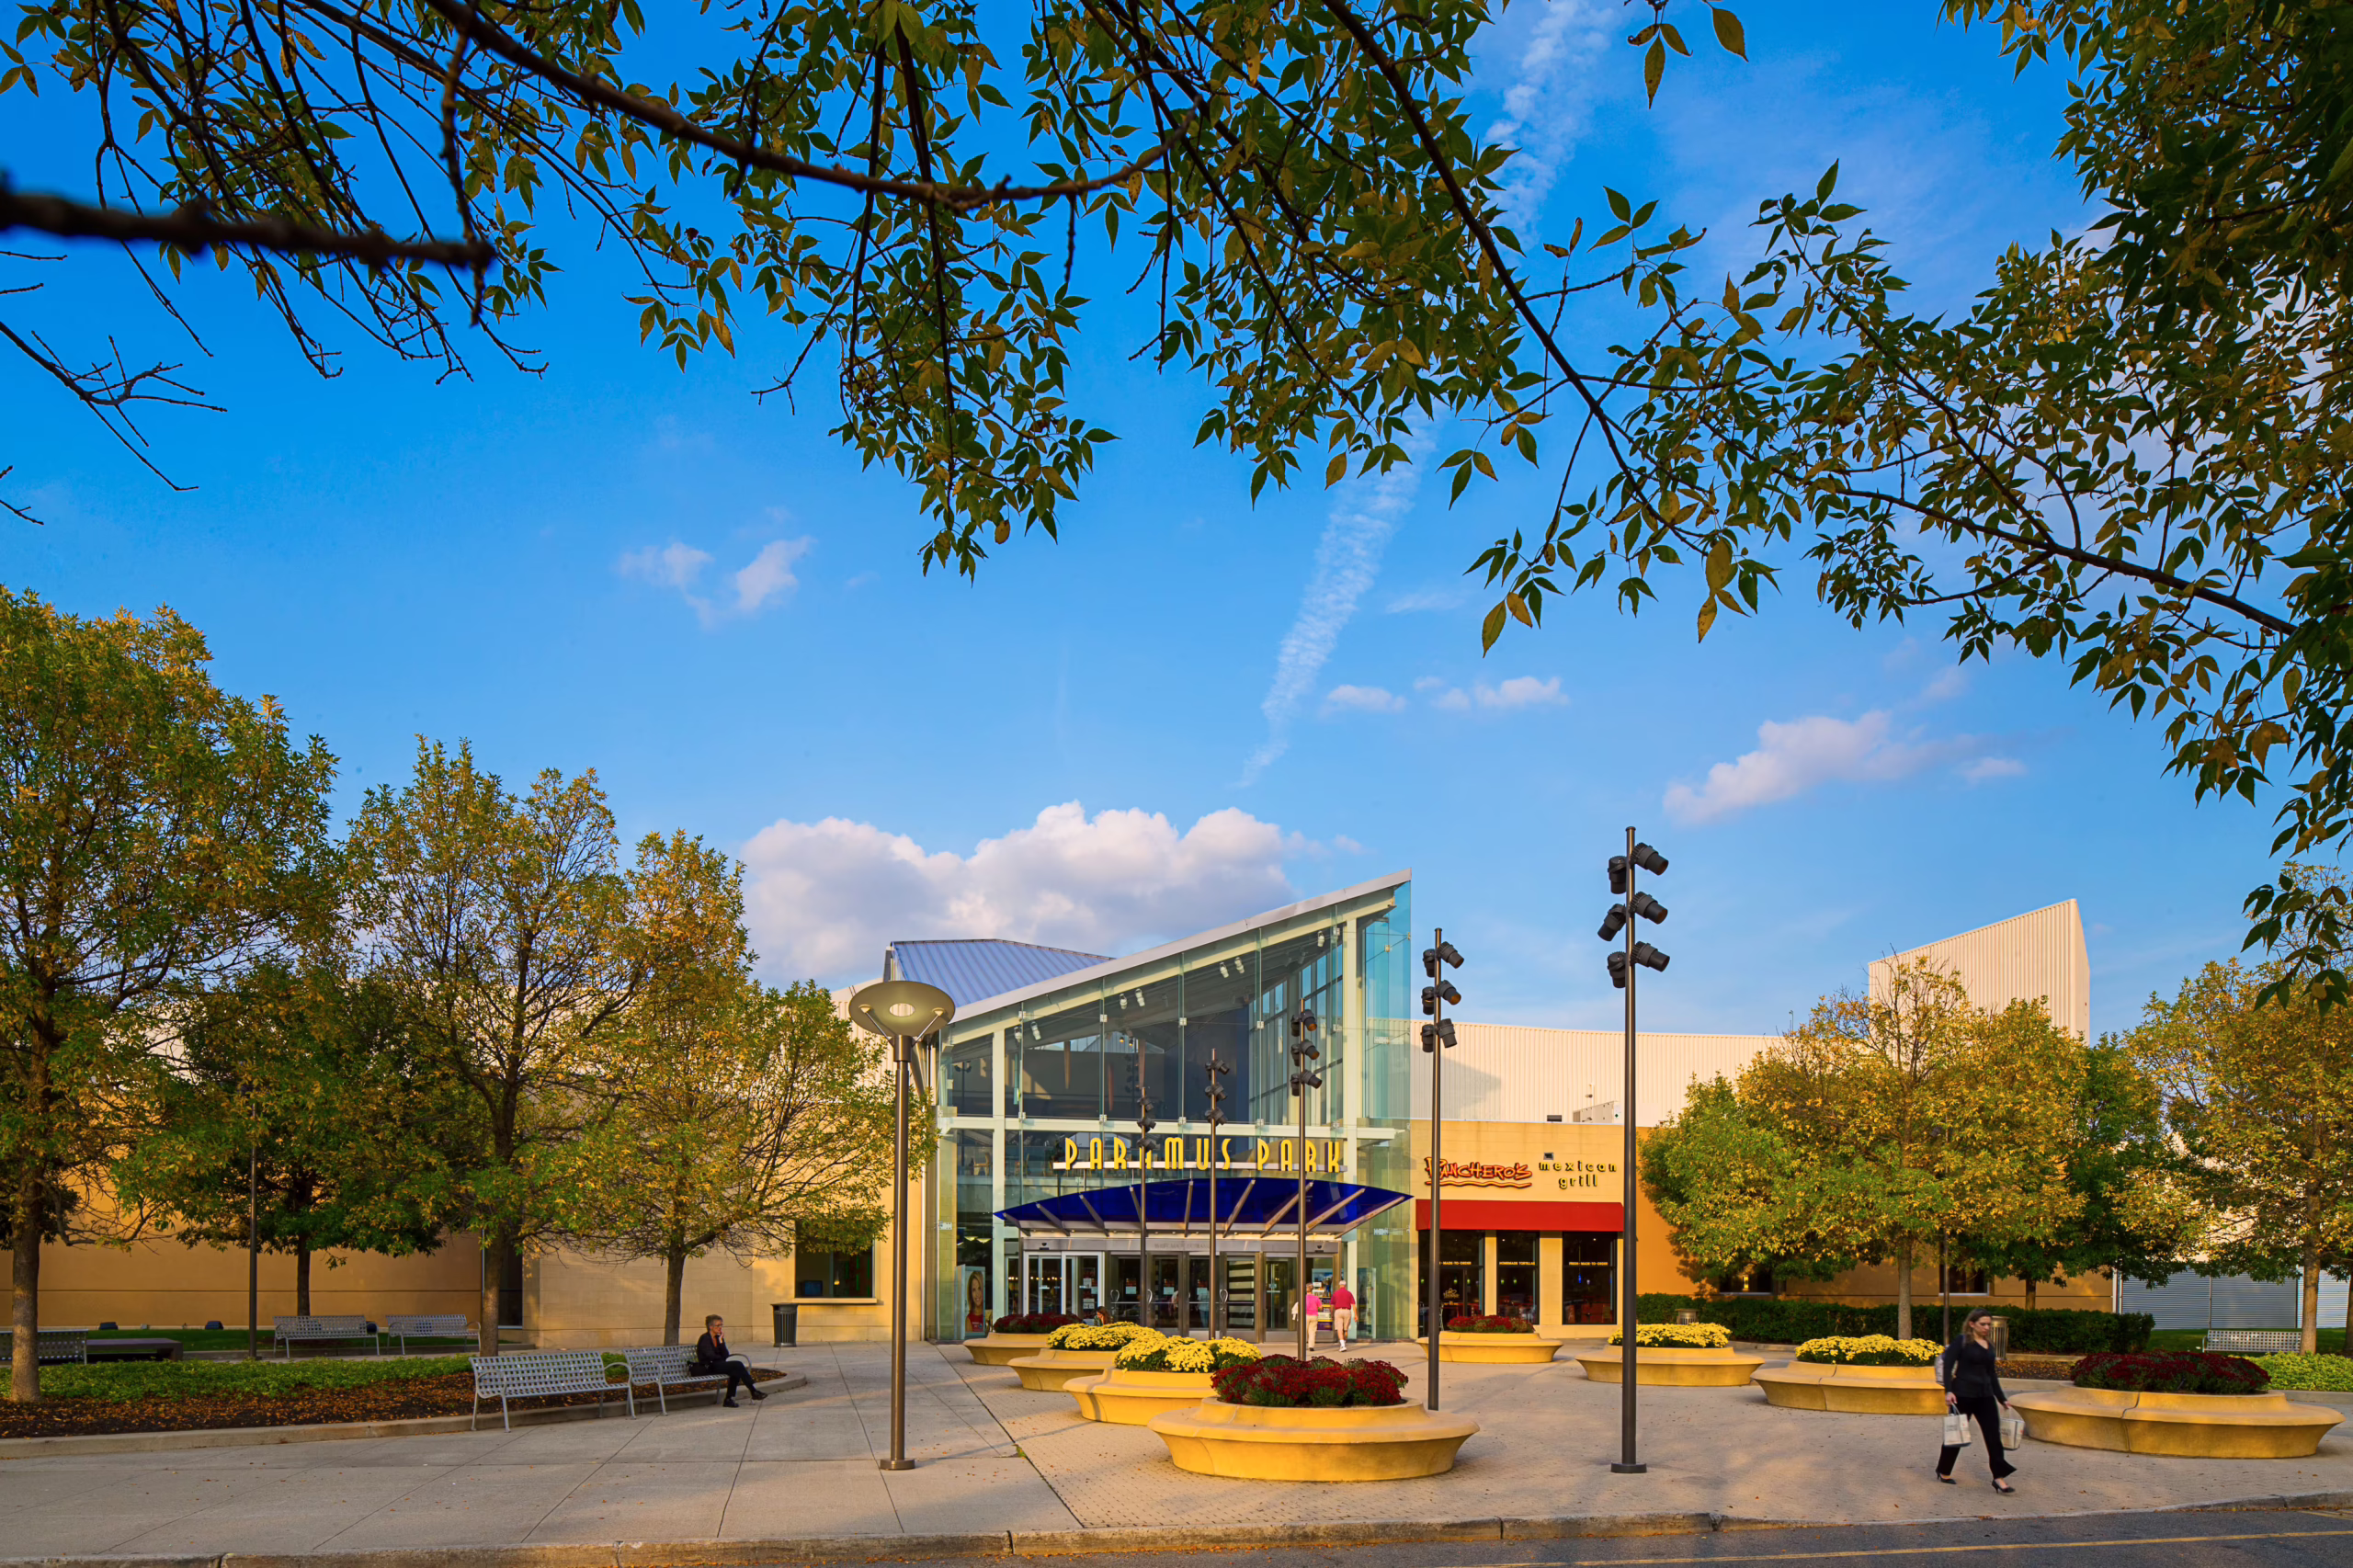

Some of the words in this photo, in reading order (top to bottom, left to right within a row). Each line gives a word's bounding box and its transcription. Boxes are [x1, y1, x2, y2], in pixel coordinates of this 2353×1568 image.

[1256, 1138, 1340, 1173] PARK
[1539, 1160, 1617, 1172] mexican
[1559, 1174, 1598, 1189] grill
